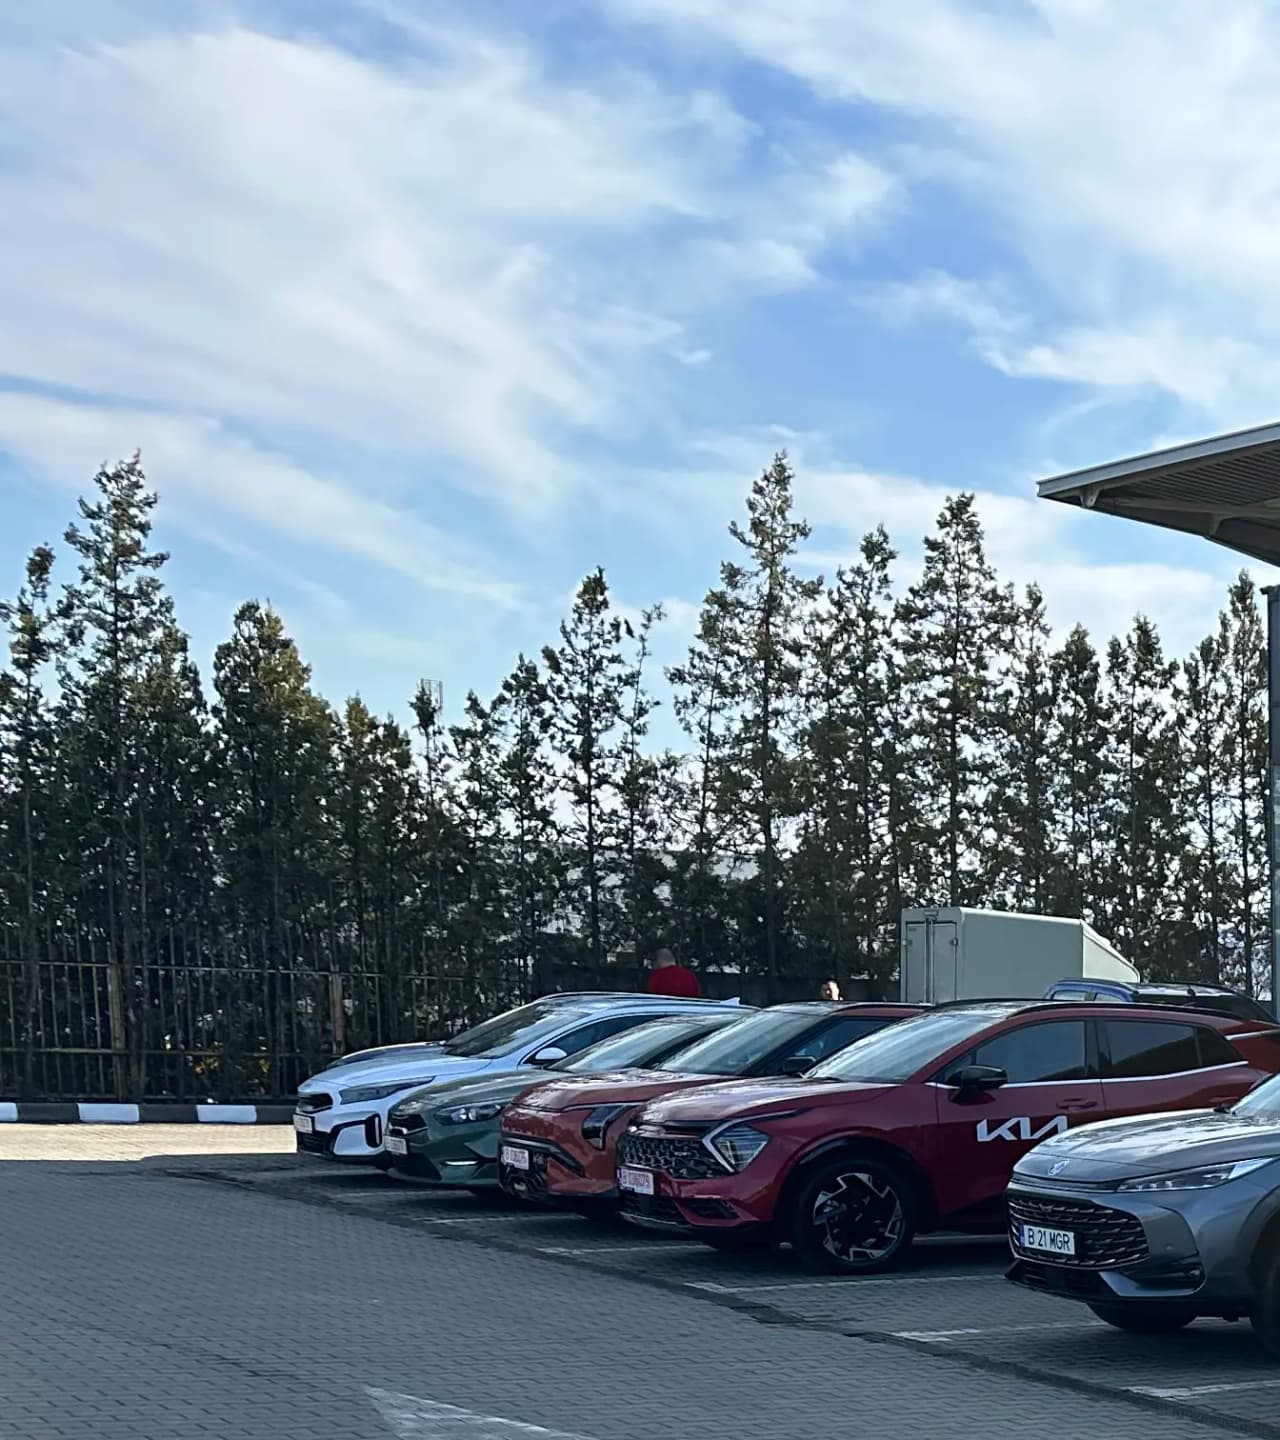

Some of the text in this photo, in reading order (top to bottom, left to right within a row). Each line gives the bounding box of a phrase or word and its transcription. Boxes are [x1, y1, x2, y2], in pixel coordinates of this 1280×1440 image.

[976, 1115, 1068, 1142] KIA
[1027, 1228, 1070, 1251] B 21 MGR
